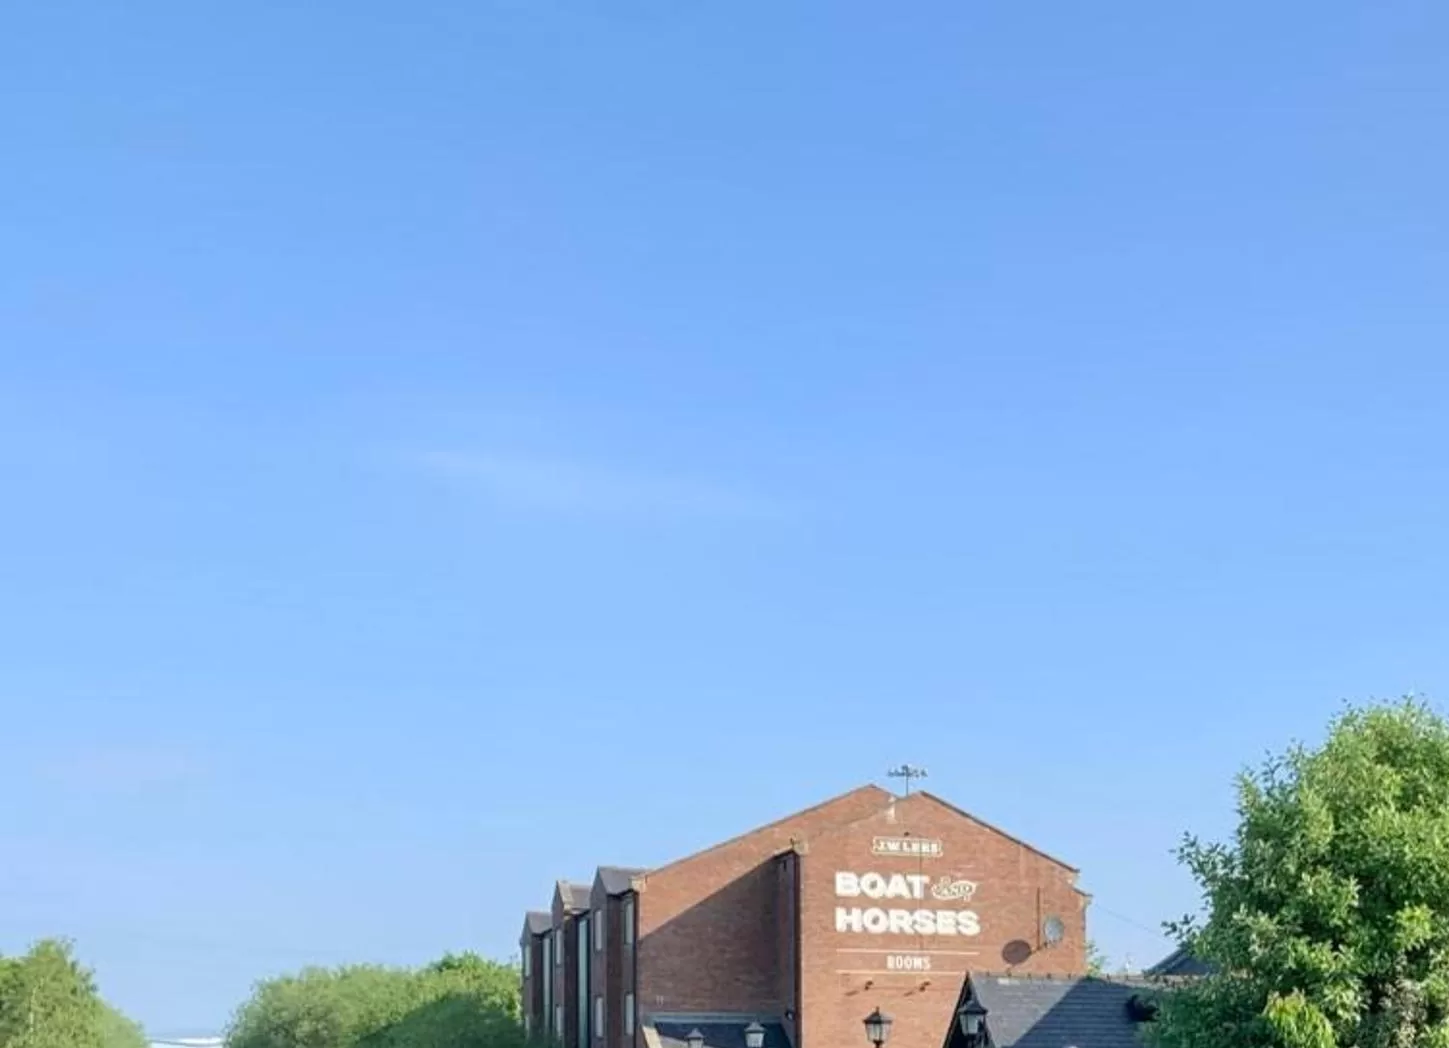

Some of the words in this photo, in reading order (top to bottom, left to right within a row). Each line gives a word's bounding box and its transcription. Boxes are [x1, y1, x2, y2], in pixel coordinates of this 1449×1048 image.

[834, 871, 930, 899] BOAT
[834, 906, 981, 936] HORSES
[886, 955, 931, 970] ROOMS
